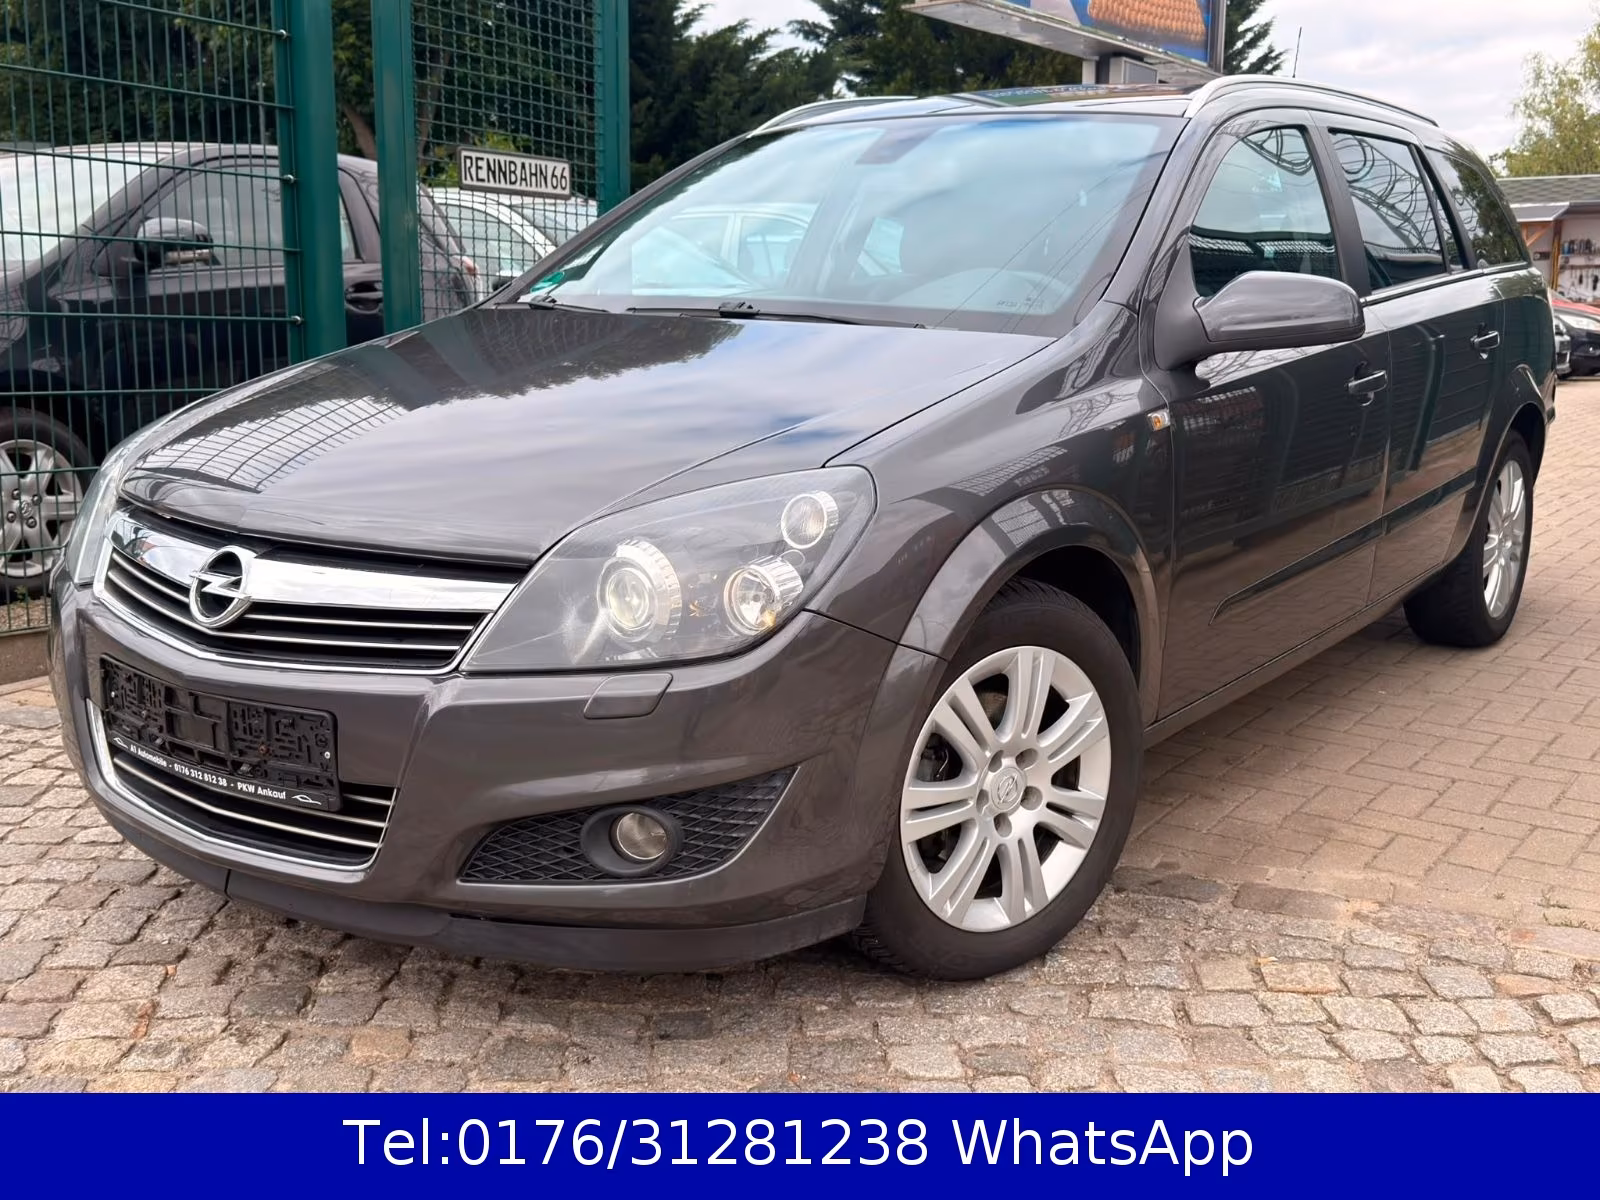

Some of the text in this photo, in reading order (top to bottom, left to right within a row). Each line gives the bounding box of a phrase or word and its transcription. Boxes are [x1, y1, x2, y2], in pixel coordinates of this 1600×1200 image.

[463, 155, 568, 190] RENNBAHN 66
[138, 747, 167, 767] Automobile
[174, 763, 190, 775] 0176
[190, 768, 203, 780] 312
[204, 773, 217, 784] 812
[218, 777, 228, 787] 38
[237, 781, 255, 793] PKW
[257, 786, 286, 800] Ankauf
